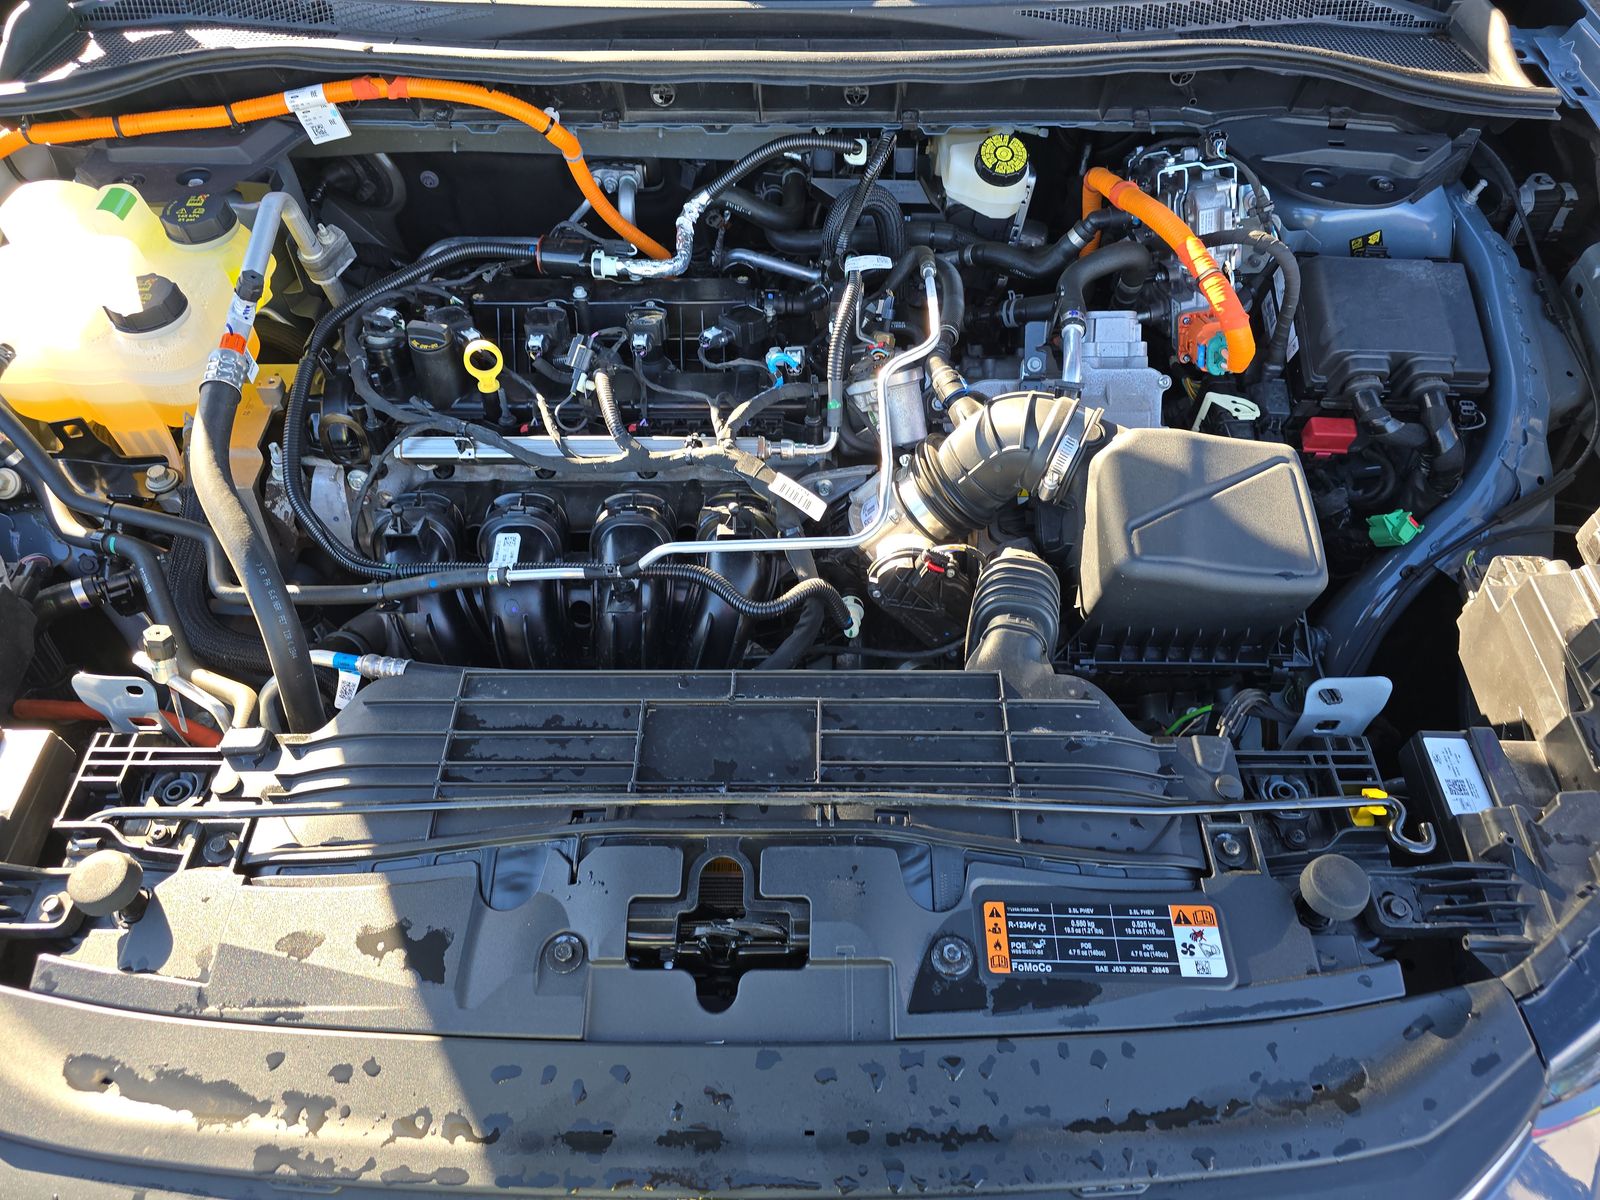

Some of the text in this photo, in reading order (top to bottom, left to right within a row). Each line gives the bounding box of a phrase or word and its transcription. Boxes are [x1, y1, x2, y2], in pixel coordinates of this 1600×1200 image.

[1008, 921, 1037, 930] R-1234yf
[1087, 920, 1095, 928] kg
[1148, 920, 1156, 929] kg
[1010, 941, 1027, 950] POE
[1142, 943, 1154, 951] POE
[1012, 962, 1053, 973] FoMoCo
[1094, 965, 1109, 973] SAE
[1129, 966, 1148, 974] J2842
